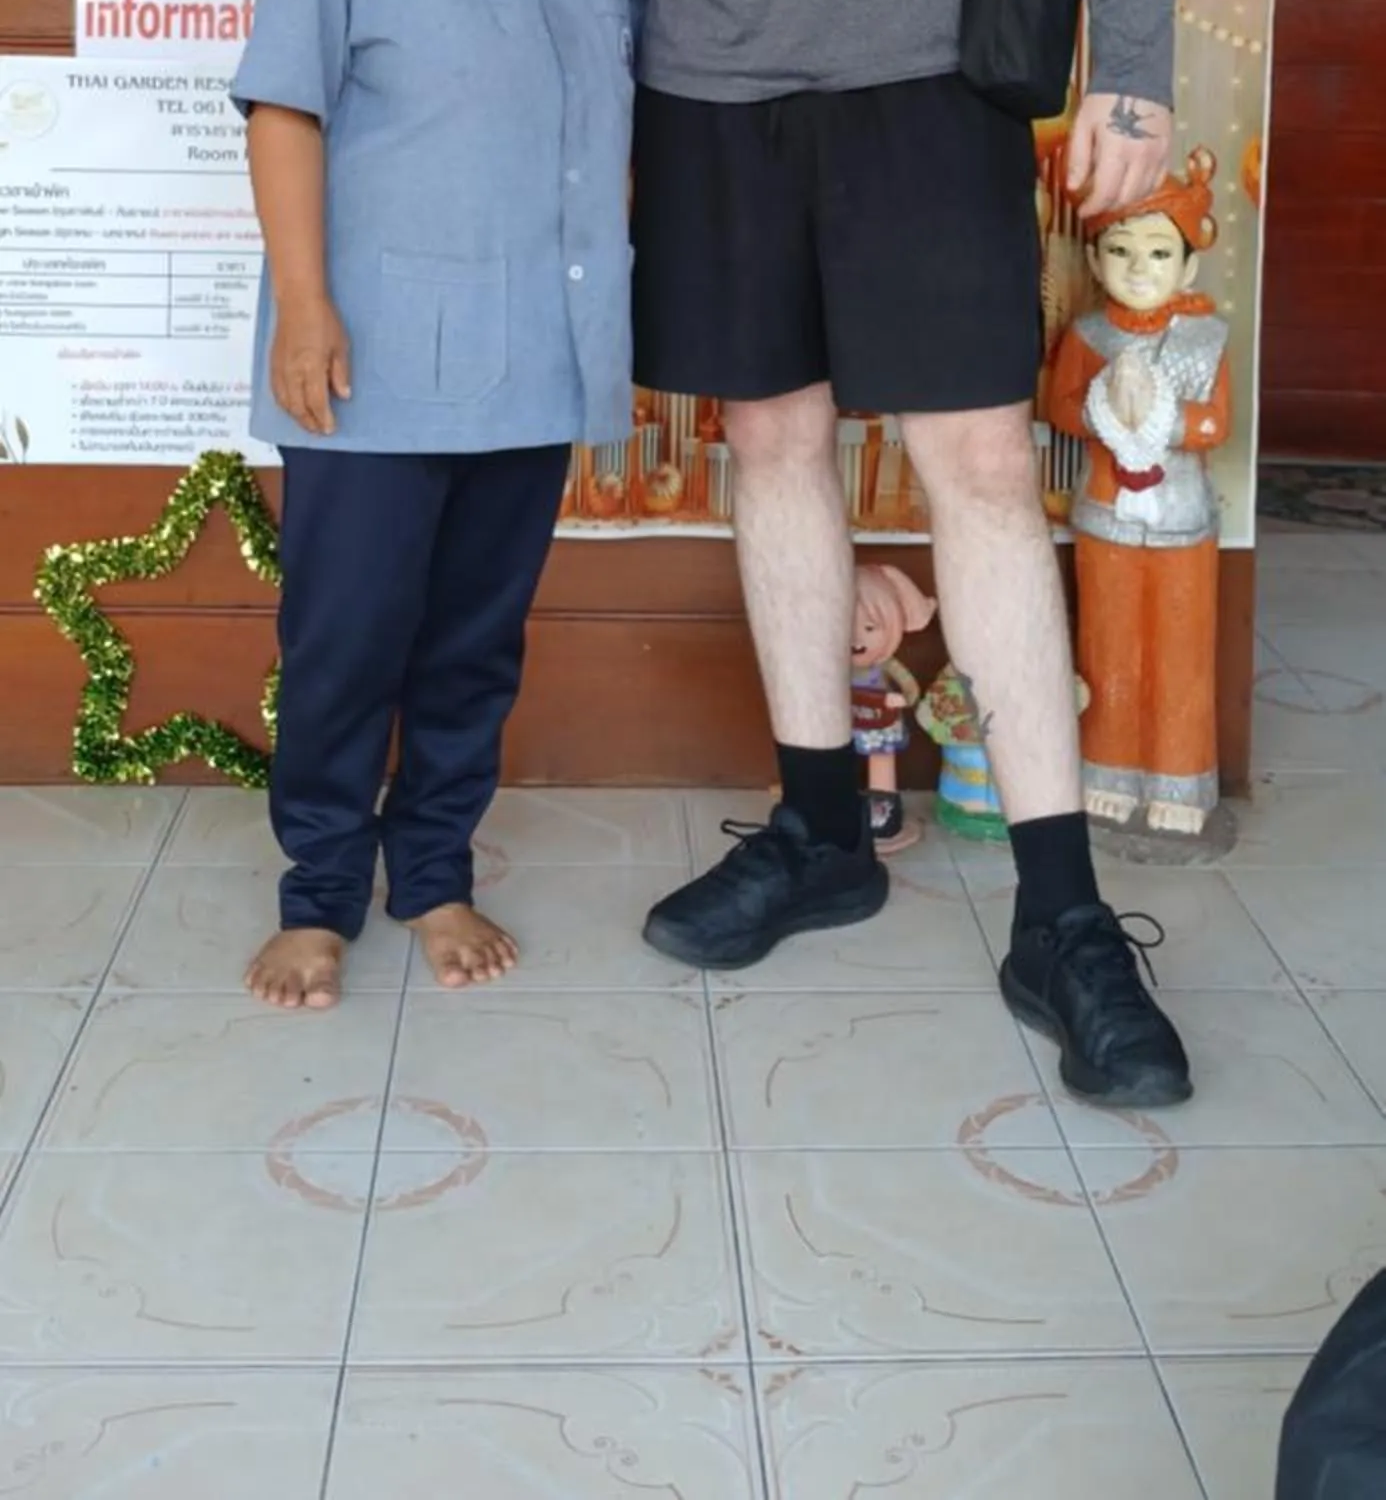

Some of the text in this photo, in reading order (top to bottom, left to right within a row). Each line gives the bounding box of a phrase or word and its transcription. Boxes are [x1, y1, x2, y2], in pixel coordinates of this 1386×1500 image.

[67, 74, 108, 90] THAI
[114, 76, 188, 91] GARDEN
[158, 99, 225, 115] TEL 061
[188, 146, 239, 161] Room
